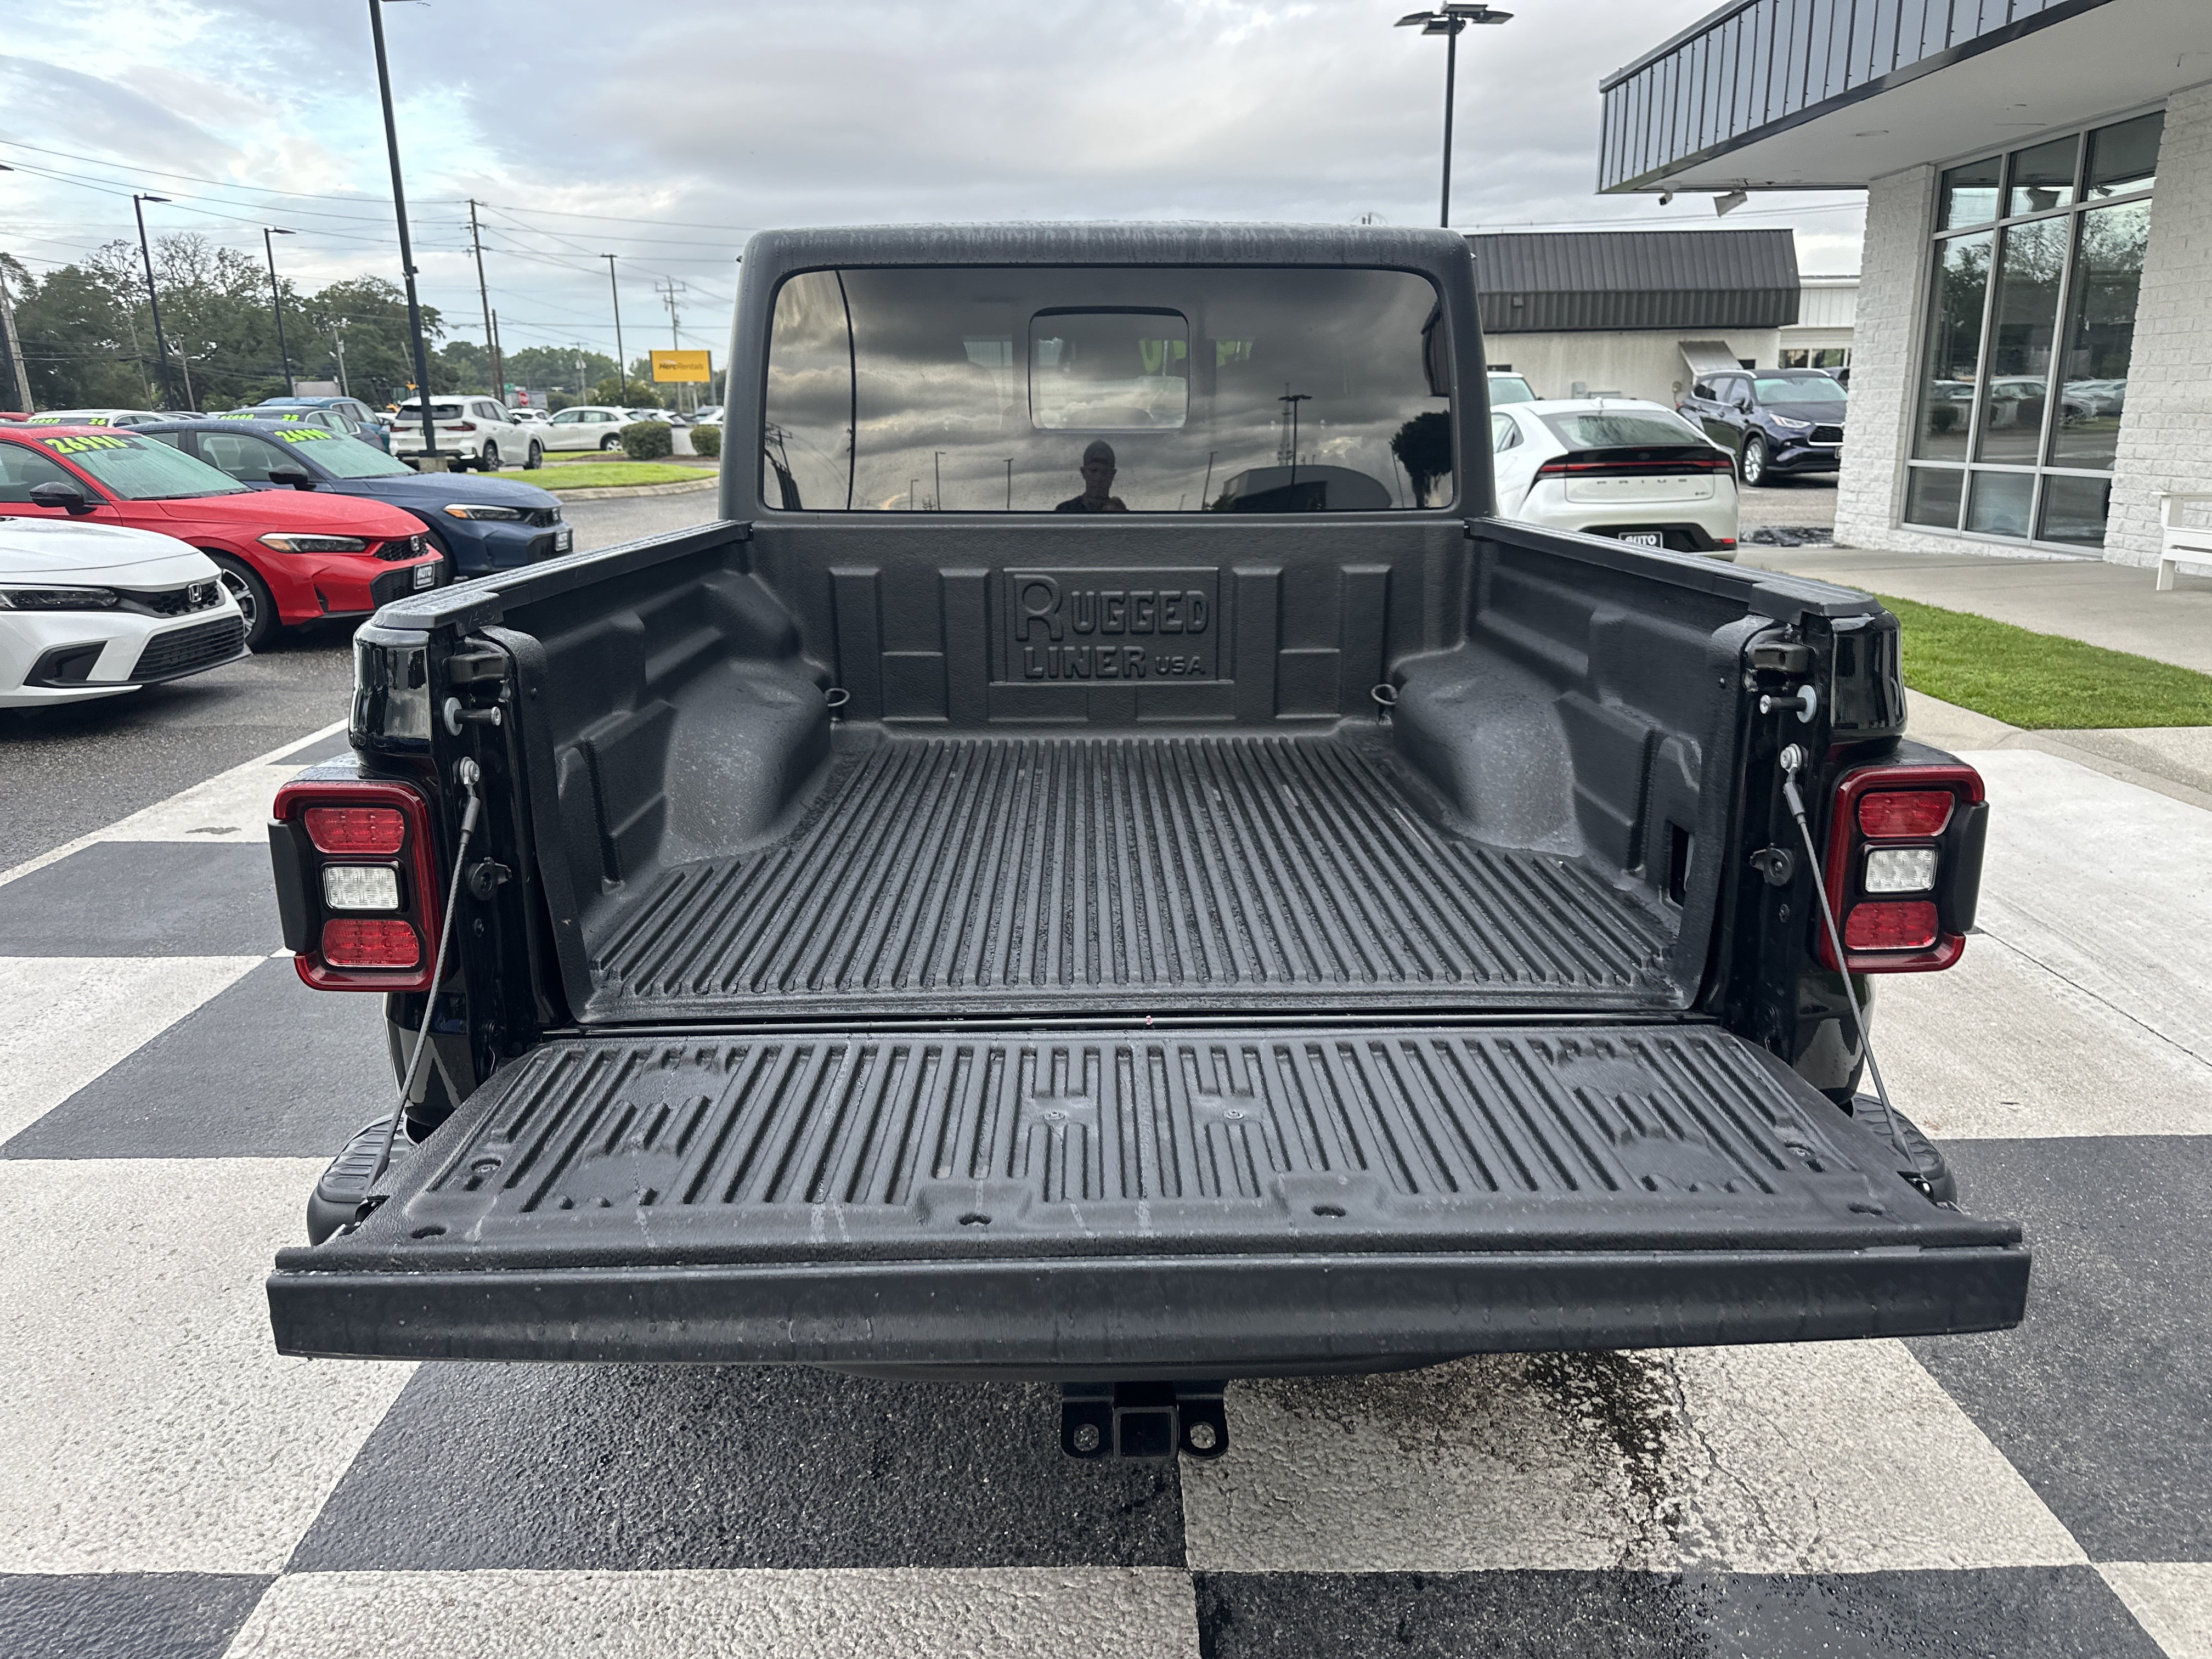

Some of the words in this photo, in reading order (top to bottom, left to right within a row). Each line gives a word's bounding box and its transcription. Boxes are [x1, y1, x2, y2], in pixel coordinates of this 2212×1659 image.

[44, 435, 129, 454] 26990
[1014, 574, 1209, 642] RUGGED
[1024, 646, 1146, 679] LINER
[1155, 656, 1206, 675] USA
